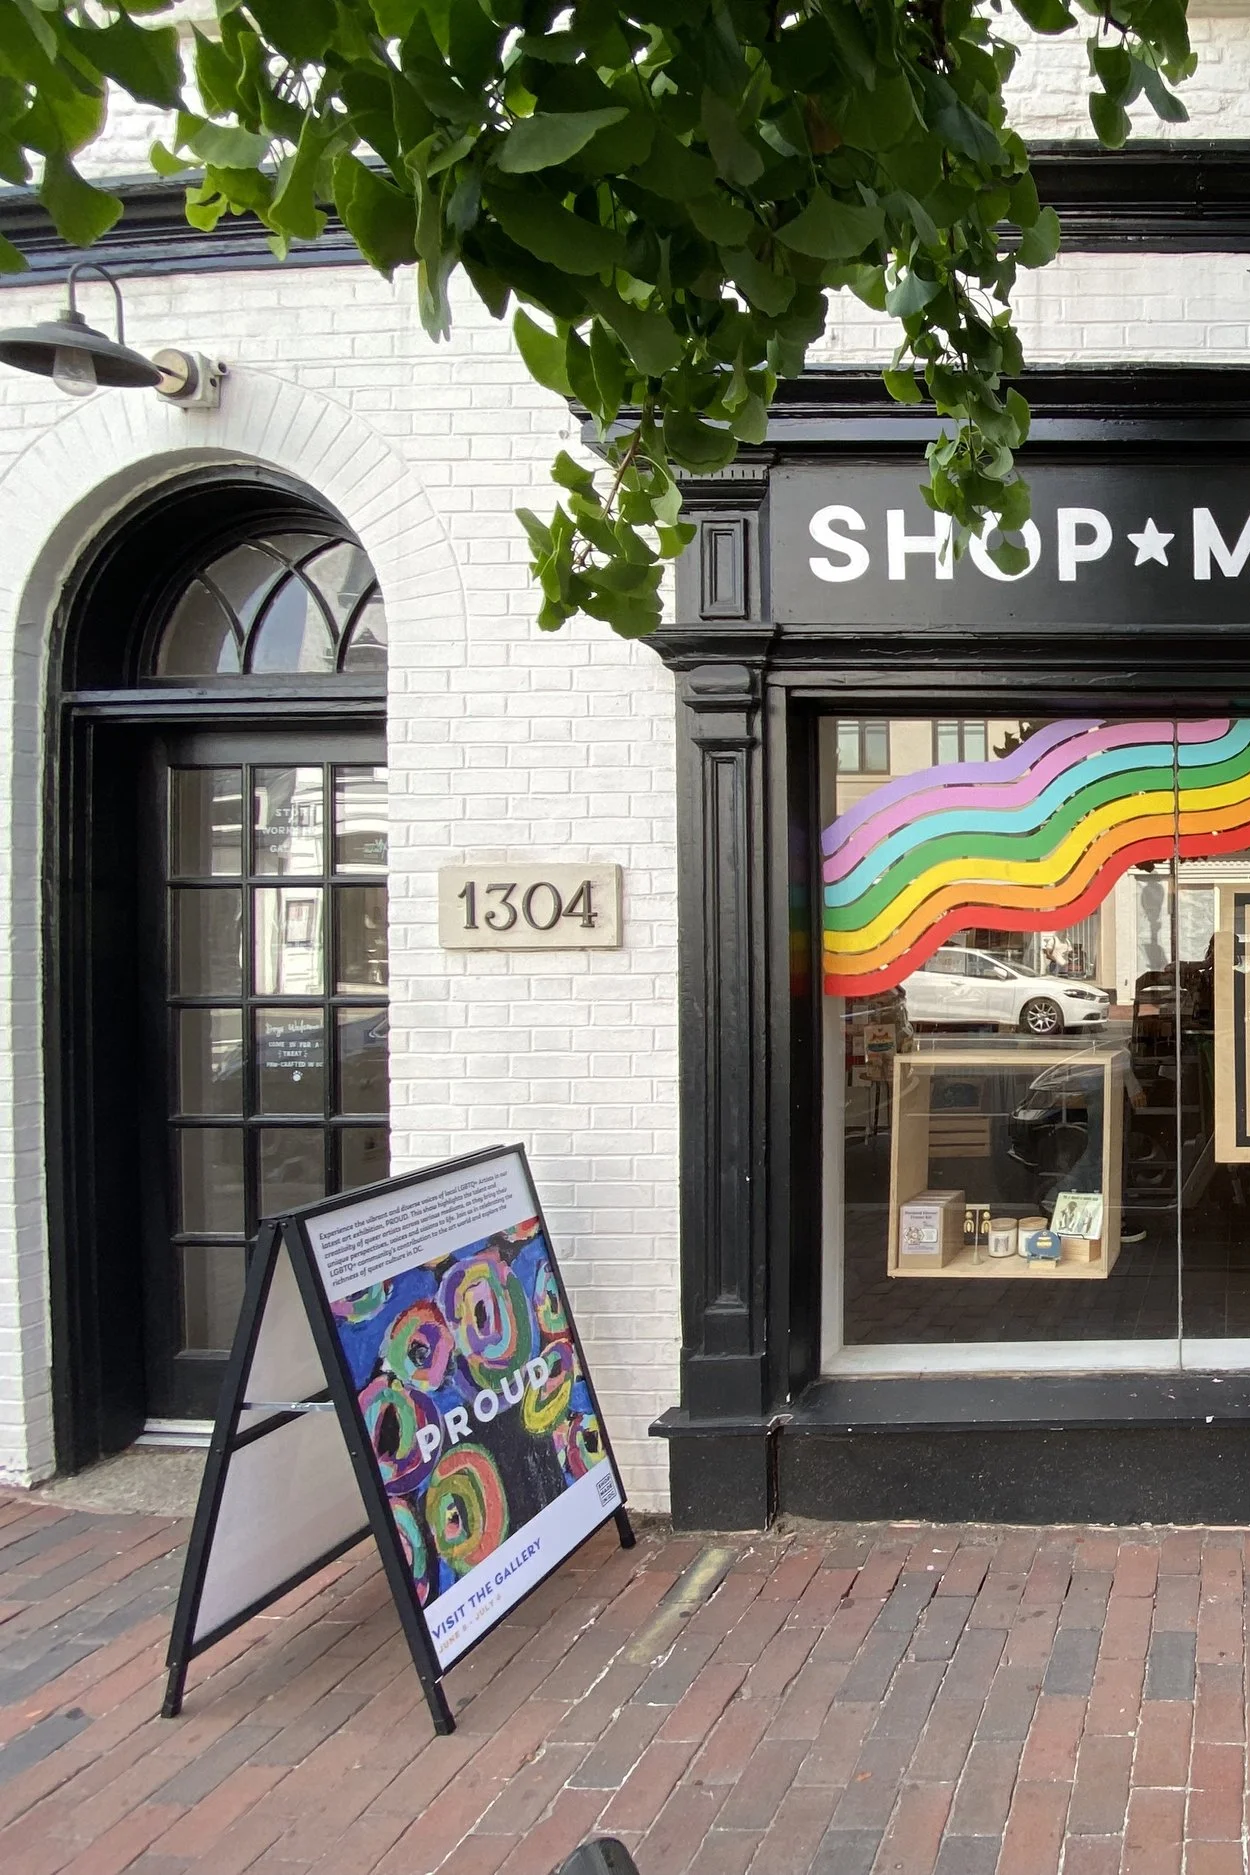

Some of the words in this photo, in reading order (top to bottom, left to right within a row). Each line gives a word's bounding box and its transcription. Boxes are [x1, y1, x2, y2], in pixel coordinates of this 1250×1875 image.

[808, 504, 1113, 583] SHOP
[458, 880, 598, 931] 1304
[319, 1224, 353, 1239] Experience
[415, 1356, 550, 1464] PROUD
[432, 1604, 466, 1639] VISIT
[467, 1581, 493, 1608] THE
[494, 1537, 542, 1586] GALLERY
[438, 1629, 461, 1653] JUNE
[475, 1599, 495, 1621] JULY
